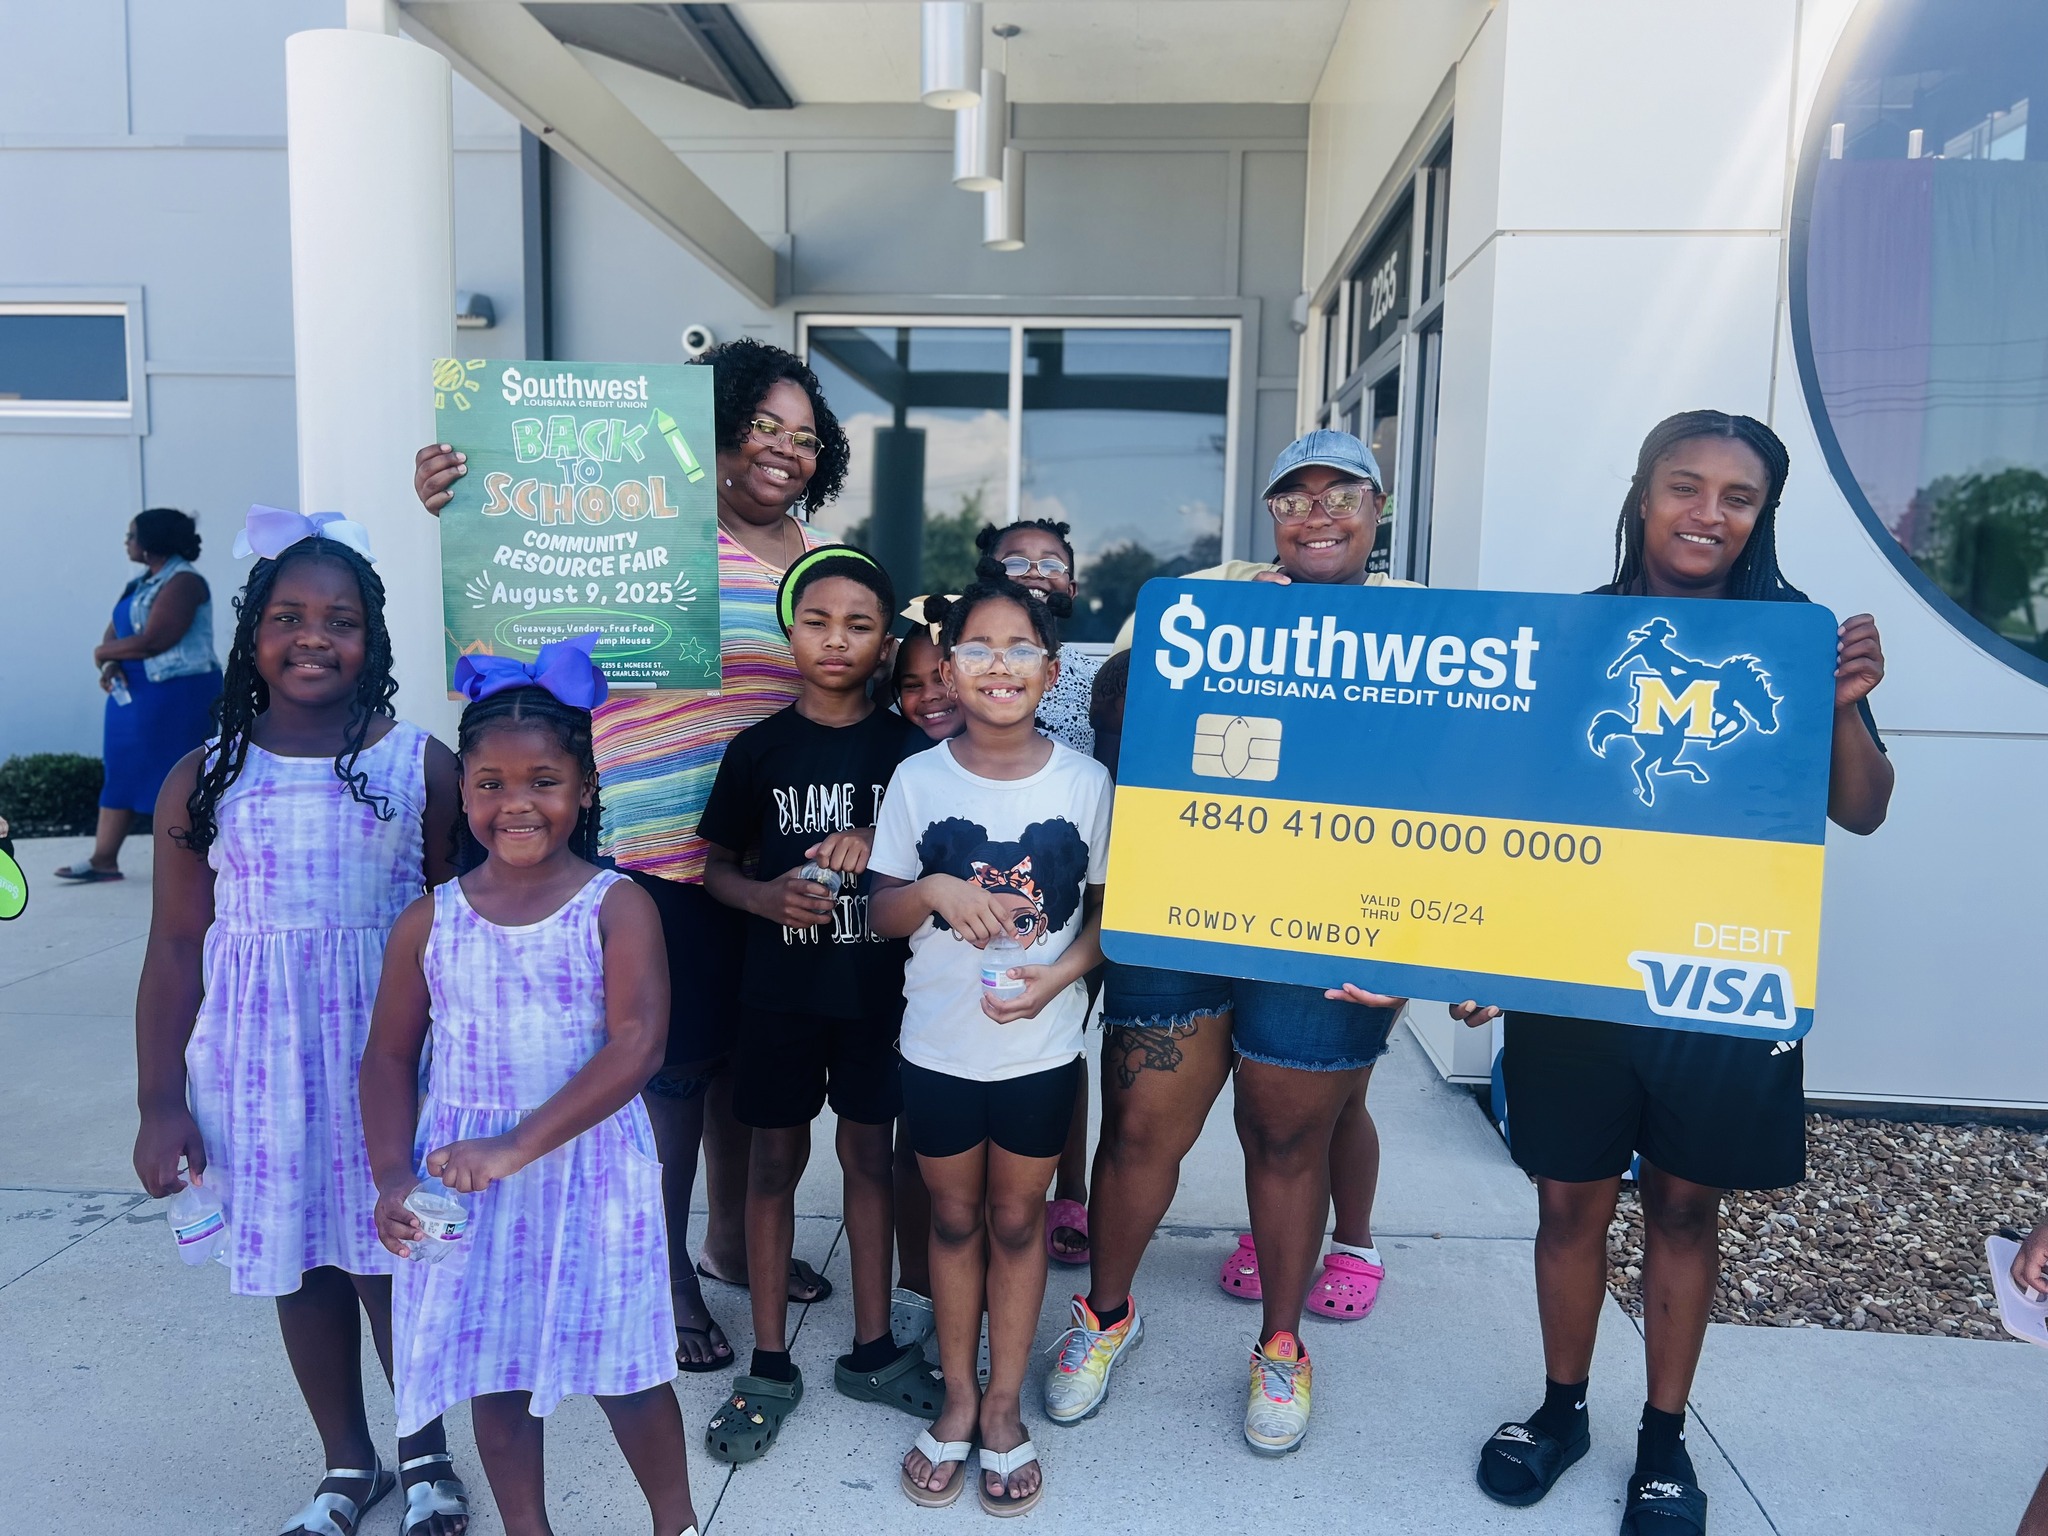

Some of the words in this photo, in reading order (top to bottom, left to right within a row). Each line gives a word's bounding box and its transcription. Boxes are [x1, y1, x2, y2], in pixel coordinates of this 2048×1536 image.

[1369, 251, 1398, 331] 2255
[524, 399, 577, 407] LOUISIANA
[578, 400, 614, 408] CREDIT
[616, 401, 647, 409] UNION
[511, 415, 648, 463] BACK
[556, 457, 602, 485] TO
[481, 472, 679, 526] SCHOOL
[523, 530, 638, 553] COMMUNITY
[493, 545, 615, 578] RESOURCE
[619, 546, 669, 574] FAIR
[491, 581, 578, 610] August
[585, 582, 607, 605] 9,
[615, 581, 673, 604] 2025
[513, 624, 565, 635] Giveaways,
[566, 624, 607, 633] Vendors,
[609, 624, 630, 633] Free
[632, 623, 654, 632] Food
[517, 636, 538, 645] Free
[620, 636, 651, 645] Houses
[612, 670, 641, 678] CHARLES,
[1203, 677, 1337, 700] LOUISIANA
[1343, 685, 1439, 707] CREDIT
[1446, 691, 1531, 713] UNION
[1632, 676, 1720, 738] M
[772, 783, 856, 836] BLAME
[1179, 800, 1268, 835] 4840
[1282, 808, 1376, 845] 4100
[1391, 818, 1487, 855] 0000
[1503, 828, 1603, 865] 0000
[1360, 893, 1401, 908] VALID
[1360, 907, 1400, 922] THRU
[1410, 898, 1485, 927] 05/24
[1168, 905, 1257, 934] ROWDY
[1269, 917, 1381, 948] COWBOY
[1694, 922, 1791, 956] DEBIT
[1636, 959, 1787, 1020] VISA
